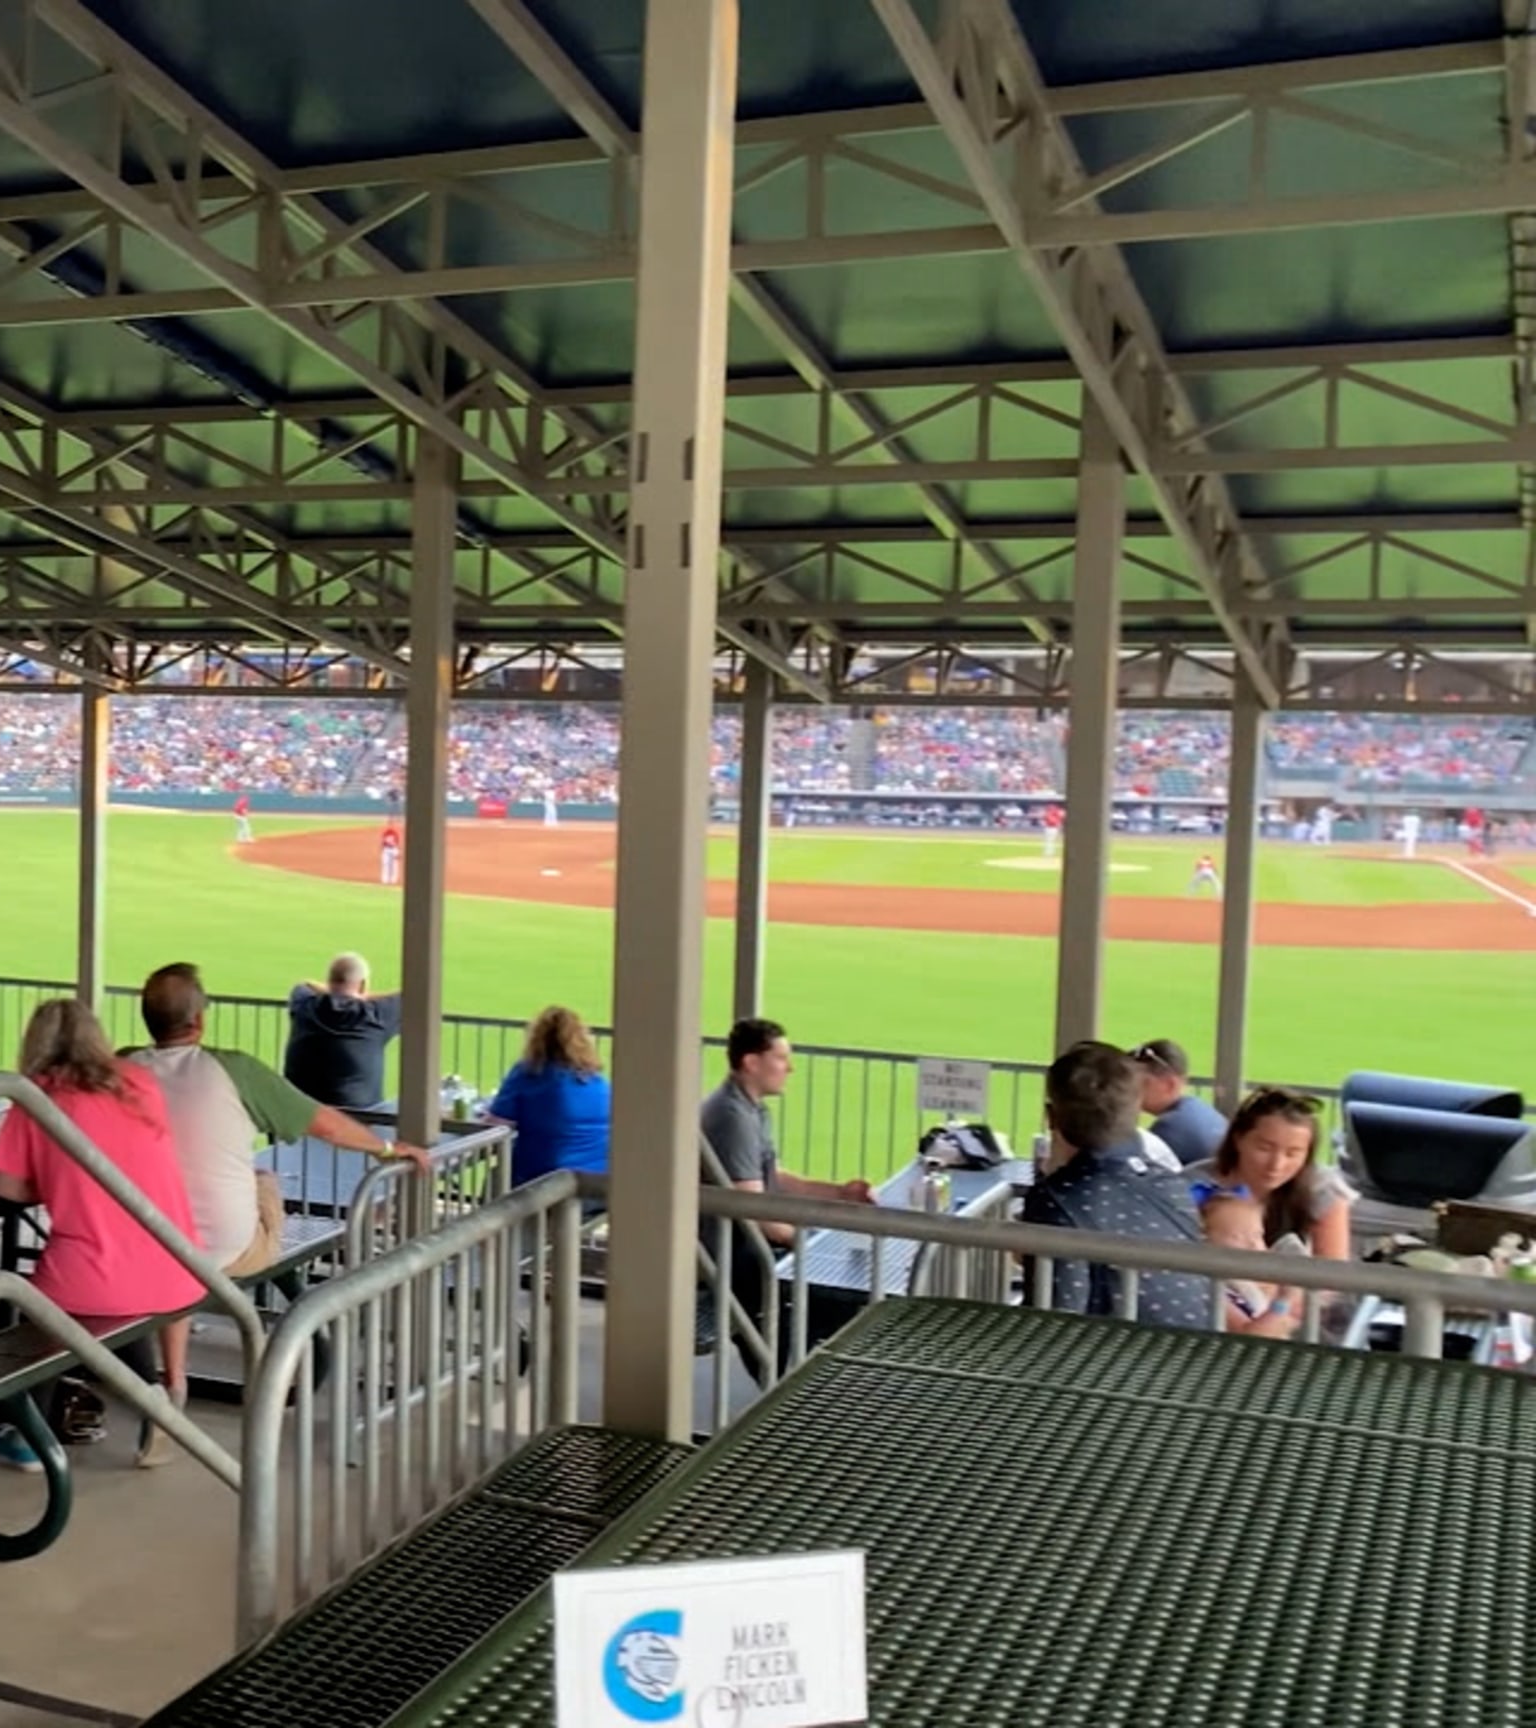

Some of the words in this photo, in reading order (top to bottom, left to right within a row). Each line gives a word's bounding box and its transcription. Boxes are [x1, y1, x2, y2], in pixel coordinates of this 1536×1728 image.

[731, 1621, 790, 1650] MARK
[723, 1650, 799, 1681] FICKEN
[715, 1677, 807, 1712] LINCOLN
